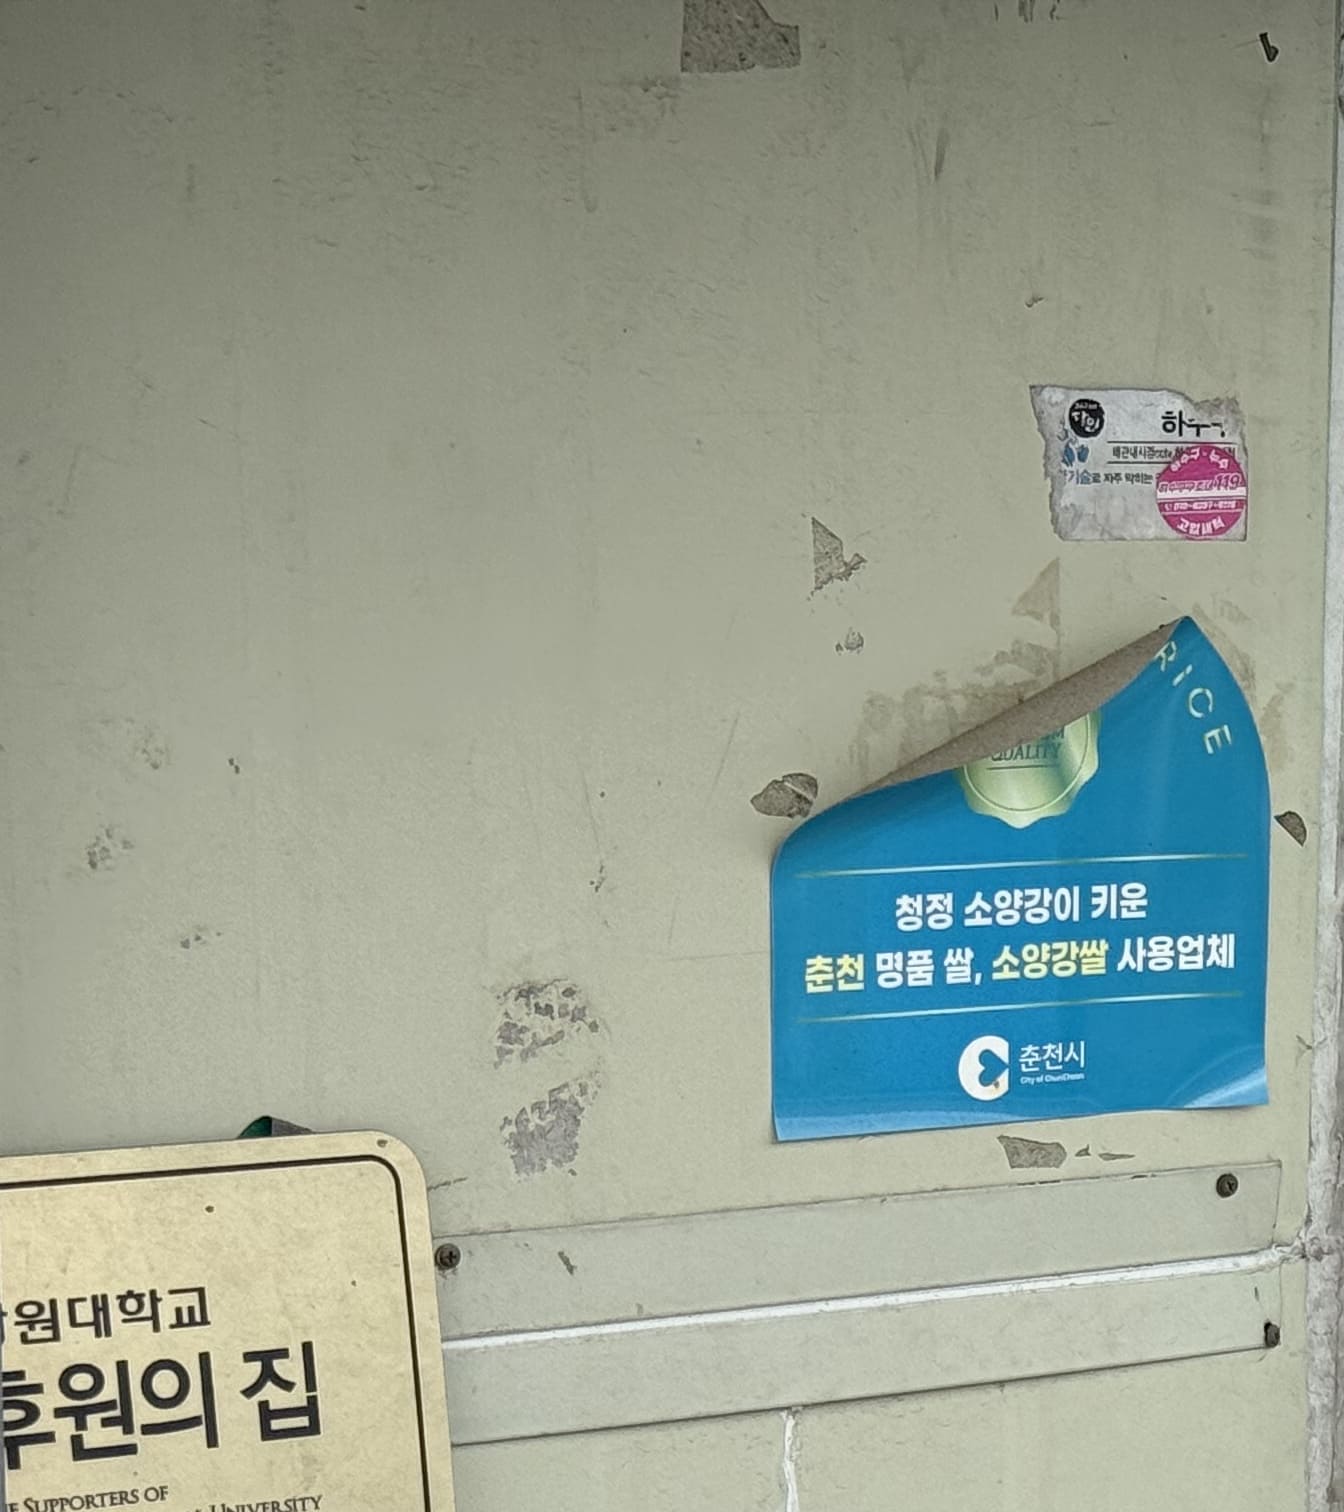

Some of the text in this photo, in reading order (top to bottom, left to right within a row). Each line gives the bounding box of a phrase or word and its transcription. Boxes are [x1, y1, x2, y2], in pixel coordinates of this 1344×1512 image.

[895, 882, 1149, 932] 청정 소양강이 키운
[804, 933, 1236, 994] 춘천 명품 쌀, 소양강쌀 사용업체
[1018, 1040, 1085, 1073] 춘천시
[0, 1286, 212, 1346] 원대학교
[1, 1341, 323, 1471] 후원의 집
[143, 1485, 170, 1502] OF
